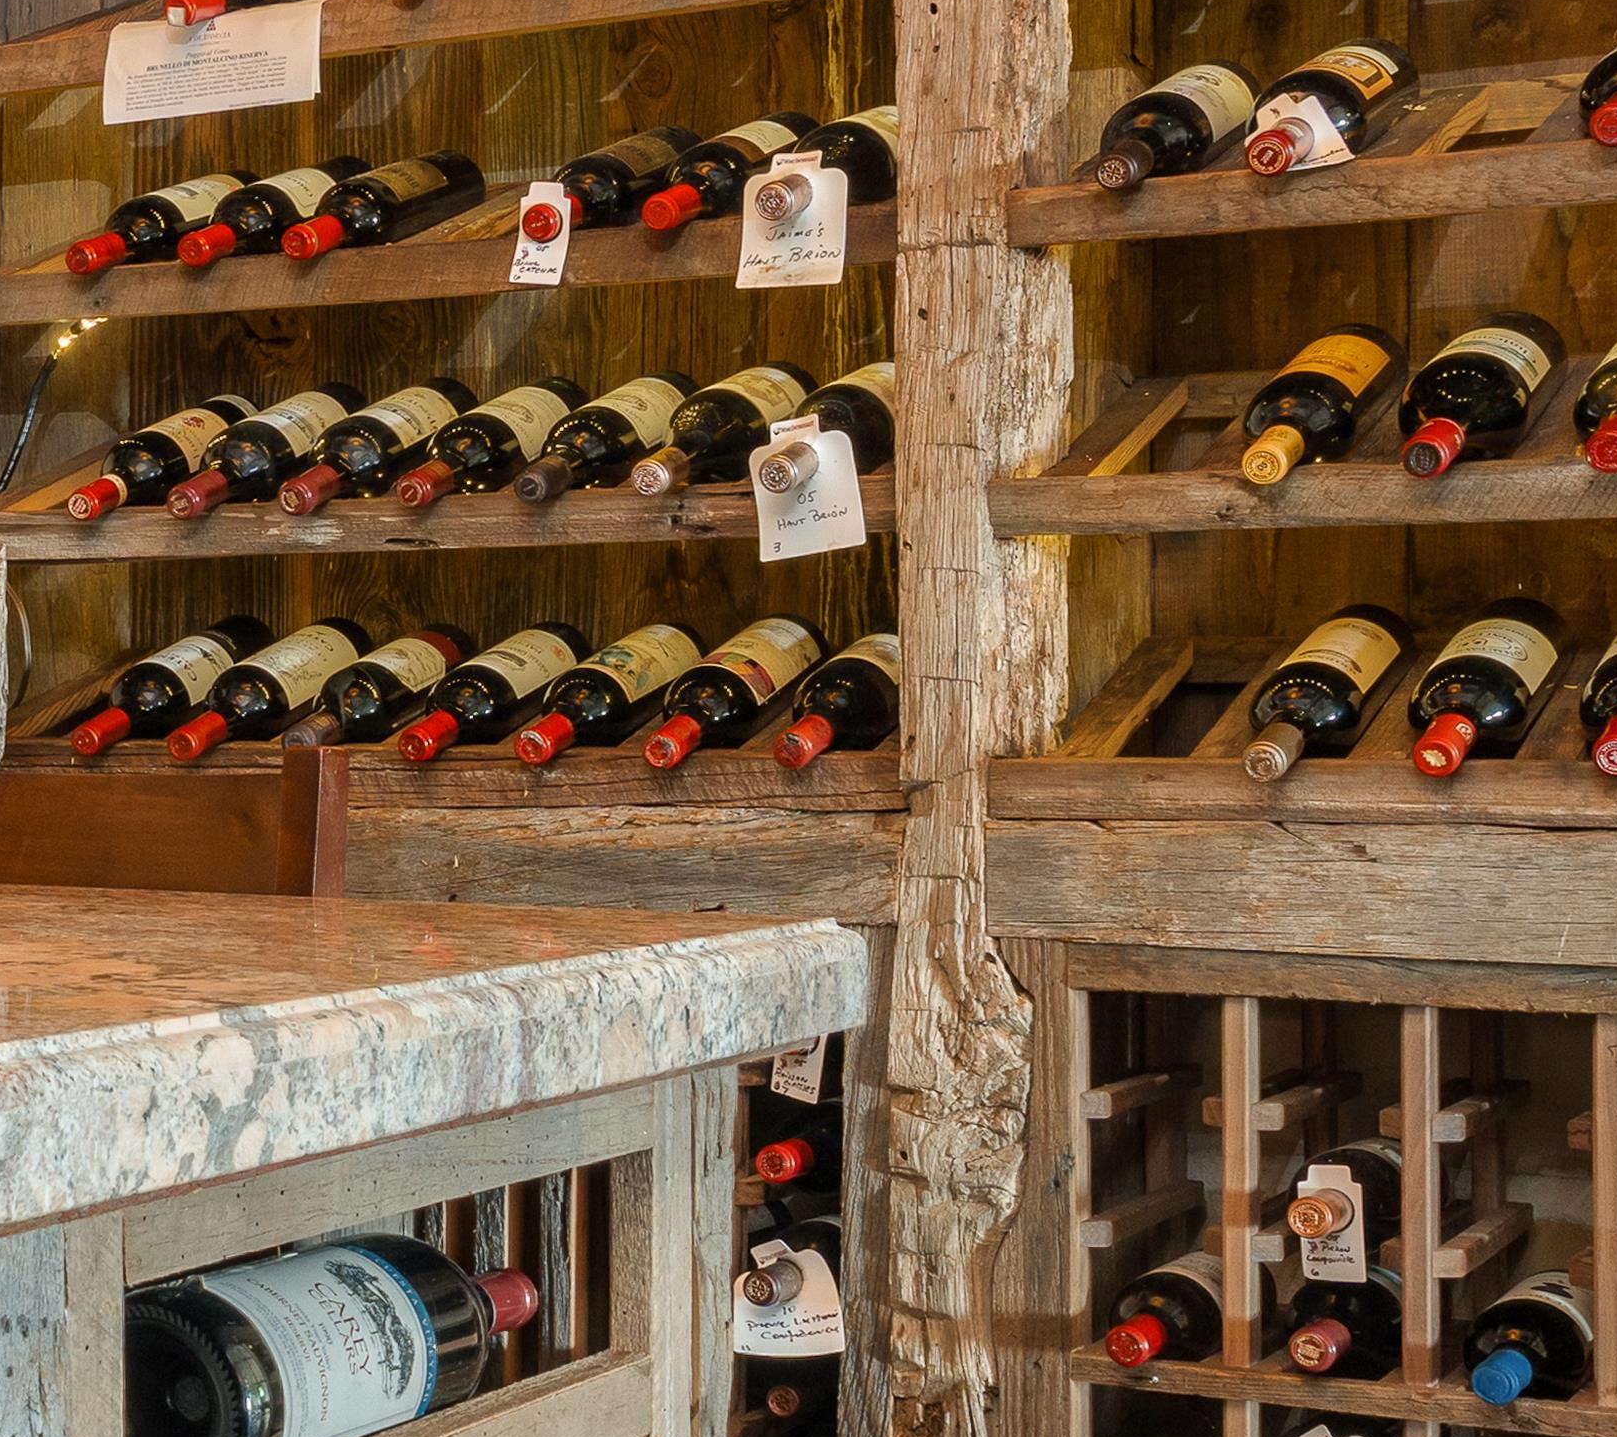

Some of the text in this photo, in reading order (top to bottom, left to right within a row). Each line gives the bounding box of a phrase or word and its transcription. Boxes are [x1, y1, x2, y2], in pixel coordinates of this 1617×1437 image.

[797, 490, 817, 505] 05
[773, 542, 782, 553] 3
[777, 517, 806, 531] HAUT
[247, 1278, 330, 1422] CABERNET SAUVIGNON
[308, 1288, 359, 1376] CELLARS
[314, 1282, 372, 1376] CAREY
